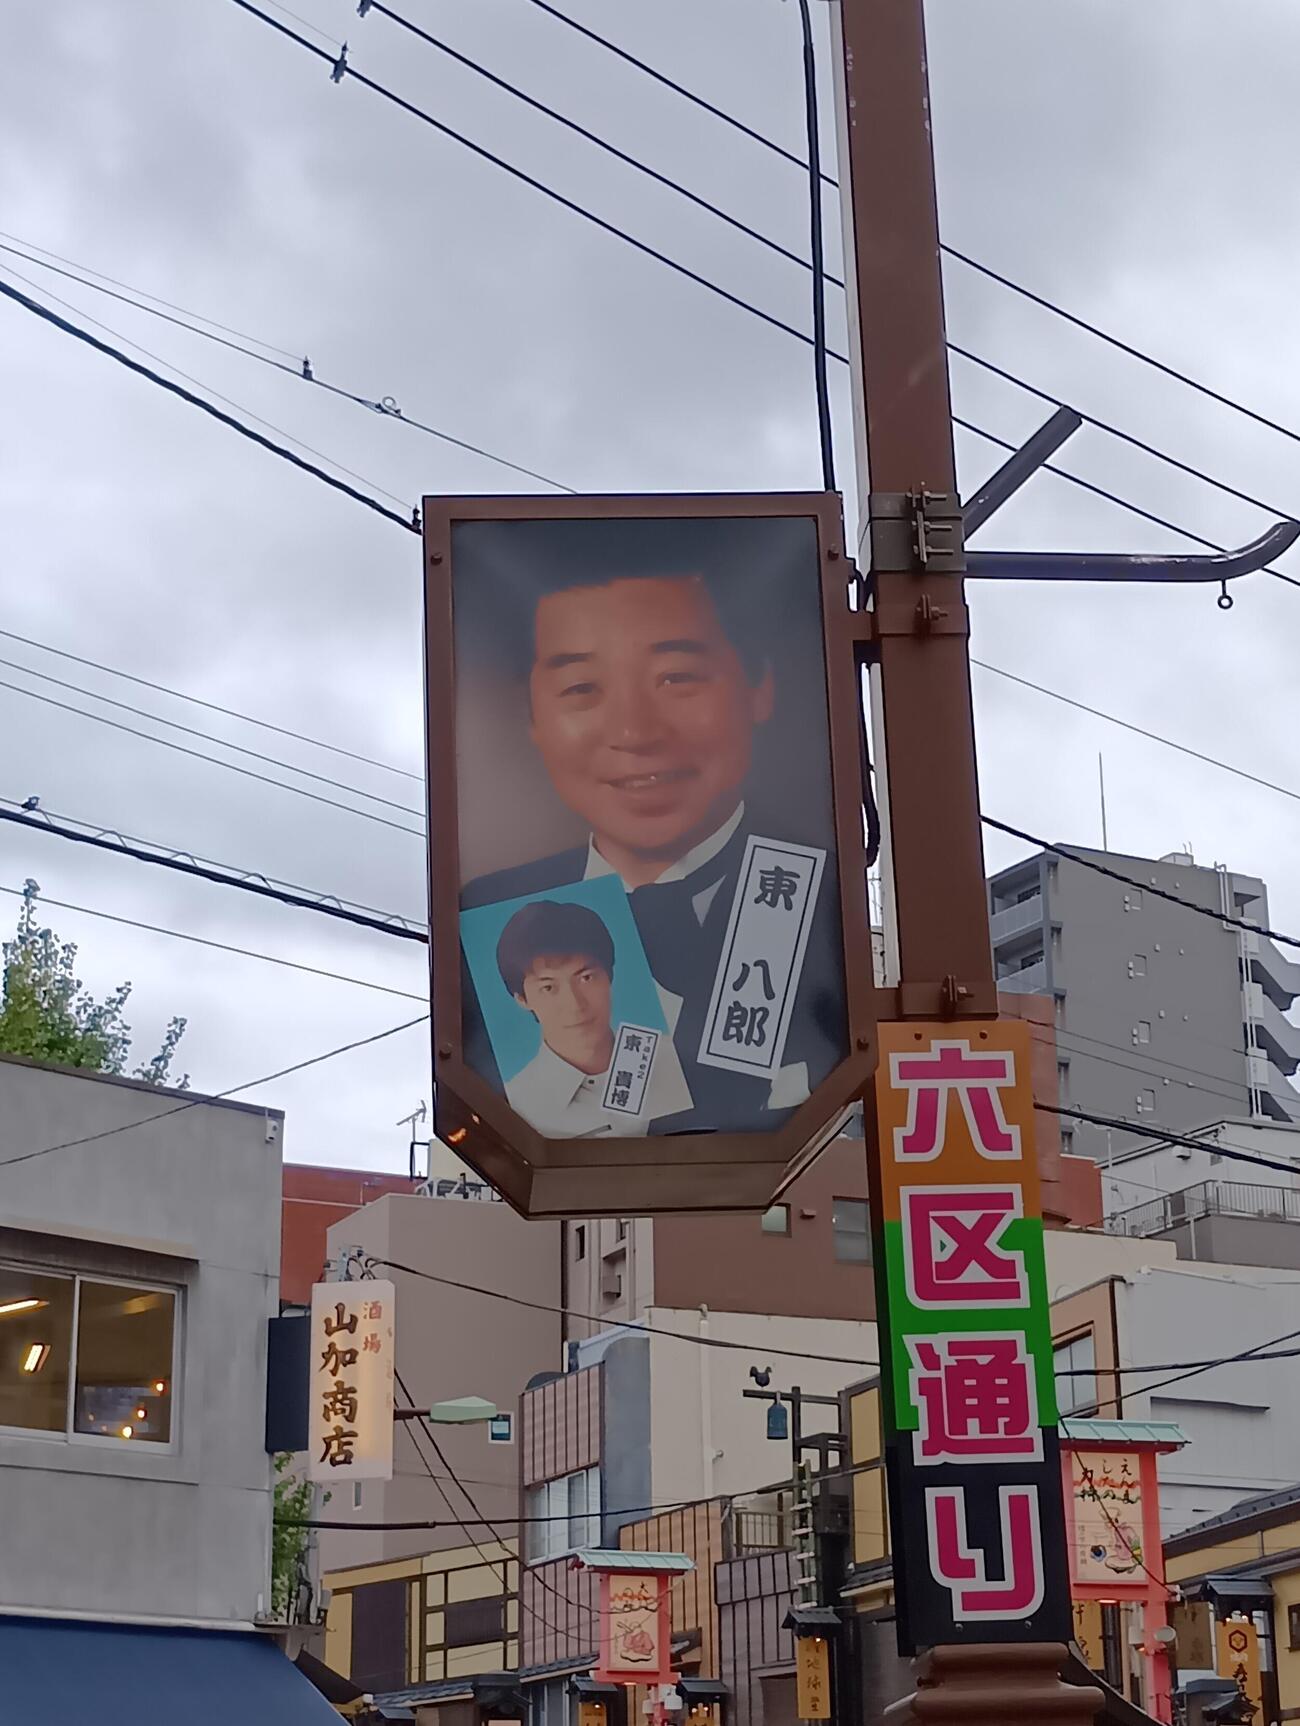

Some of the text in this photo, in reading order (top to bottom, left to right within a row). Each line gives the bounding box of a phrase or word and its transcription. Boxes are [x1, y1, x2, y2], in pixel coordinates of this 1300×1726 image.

[610, 1034, 643, 1107] 東貴博
[637, 1036, 654, 1080] Take2
[362, 1300, 382, 1354] 酒場
[889, 1040, 1044, 1622] 六区通り
[318, 1302, 359, 1468] 山加商店
